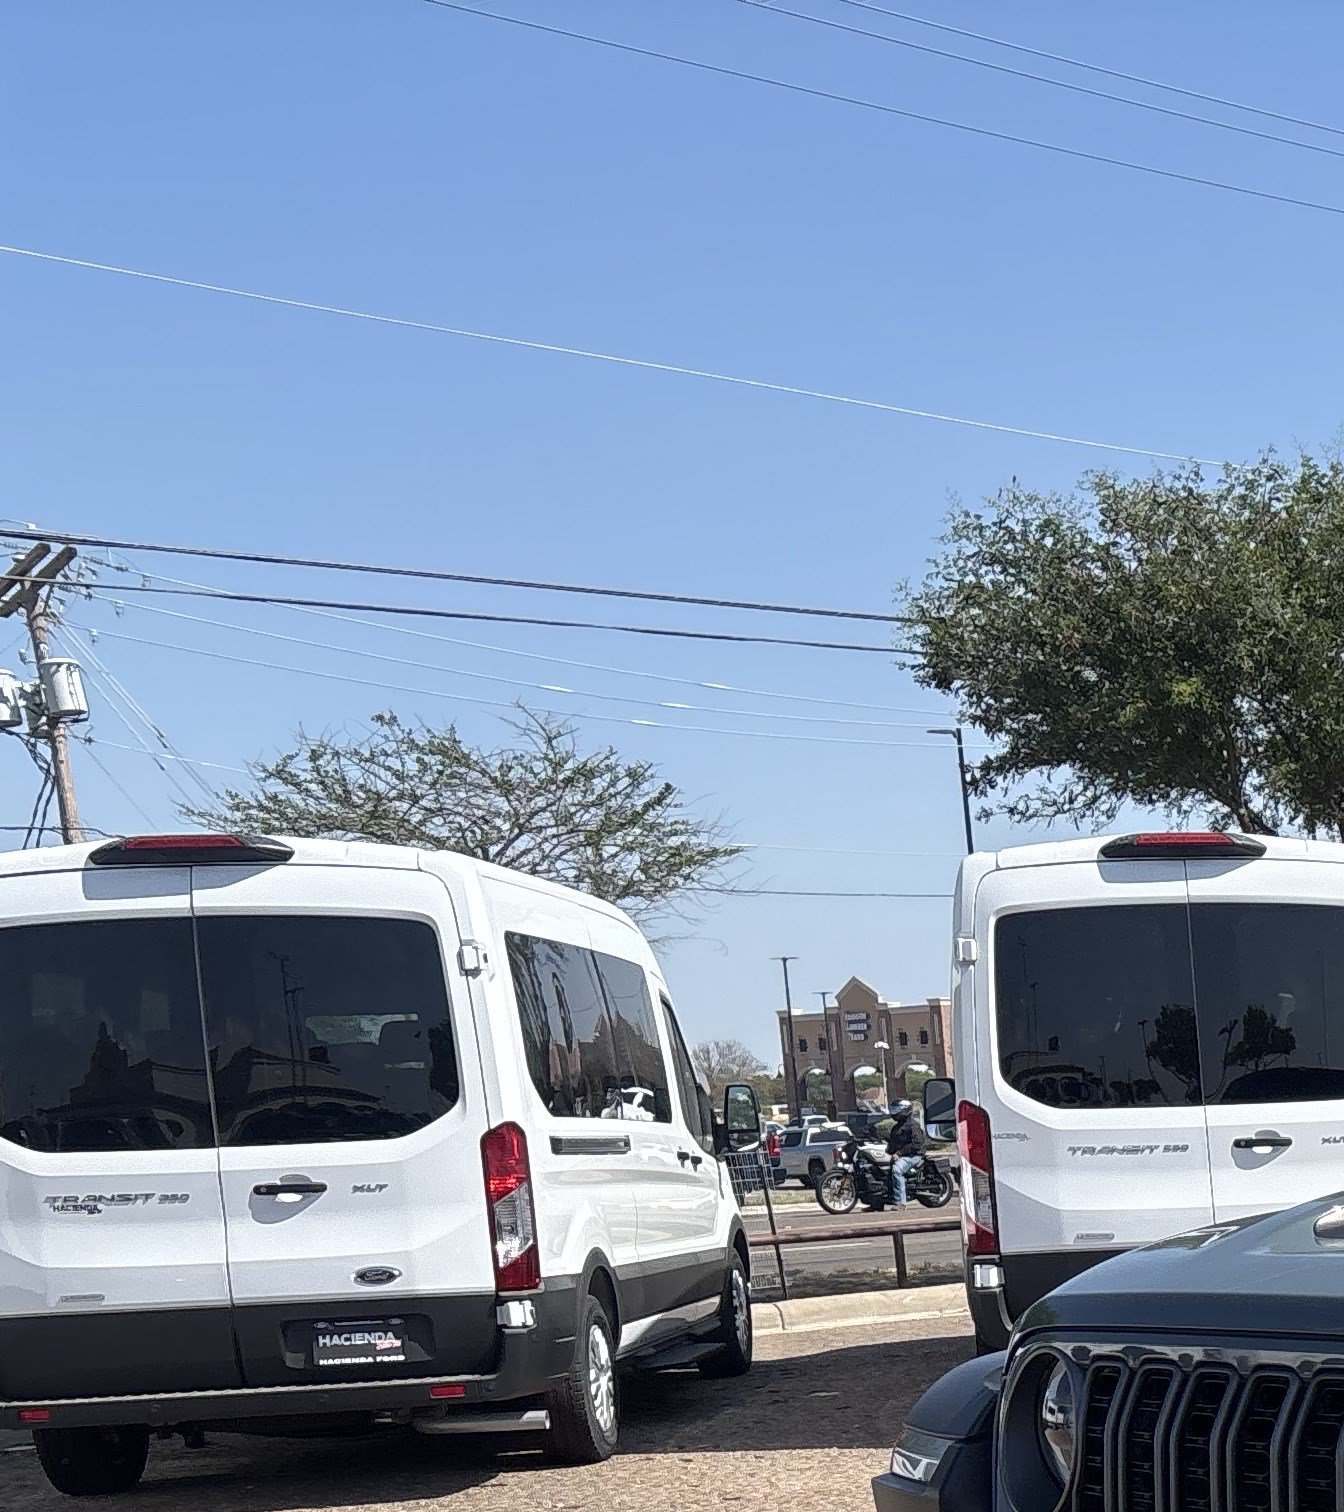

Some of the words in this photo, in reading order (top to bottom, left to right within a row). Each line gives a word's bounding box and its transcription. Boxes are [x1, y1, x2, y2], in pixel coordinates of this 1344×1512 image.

[1066, 1144, 1160, 1157] TRANSIT
[350, 1183, 390, 1195] XLT
[42, 1192, 157, 1207] TRANSIT
[52, 1204, 100, 1213] HACIENDA
[318, 1331, 395, 1348] HACIENDA
